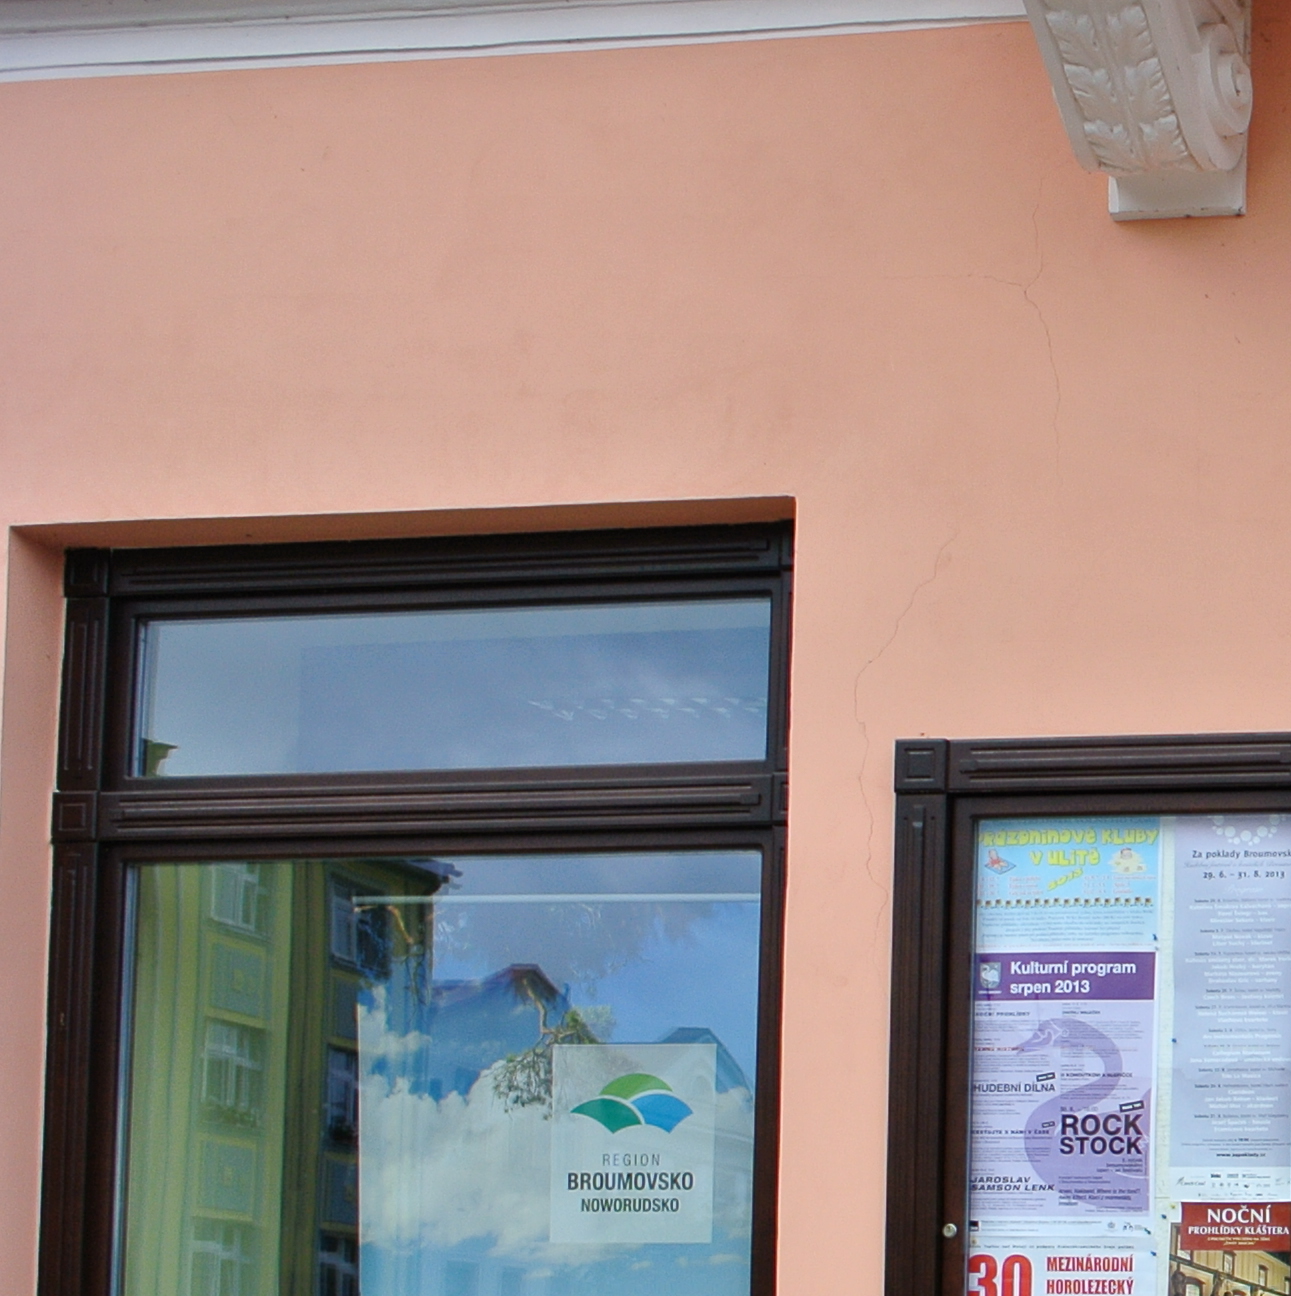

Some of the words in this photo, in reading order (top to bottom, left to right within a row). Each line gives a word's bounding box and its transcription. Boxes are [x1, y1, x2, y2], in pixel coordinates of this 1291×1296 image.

[1191, 849, 1203, 859] Za
[1205, 849, 1241, 860] poklady
[1265, 870, 1285, 880] 2013
[1010, 960, 1069, 975] Kulturní
[1071, 962, 1137, 977] program
[1010, 981, 1051, 996] srpen
[1054, 980, 1091, 994] 2013
[973, 1081, 1021, 1093] HUDEBNÍ
[1024, 1081, 1056, 1093] DÍLNA
[1060, 1113, 1143, 1136] ROCK
[1059, 1136, 1143, 1155] STOCK
[602, 1153, 661, 1167] REGION
[567, 1172, 694, 1191] BROUMOVSKO
[971, 1176, 1031, 1184] JAROSLAV
[970, 1184, 1021, 1192] SAMSON
[581, 1198, 680, 1212] NOWORUDSKO
[1207, 1204, 1272, 1224] NOČNÍ
[1188, 1225, 1242, 1235] PROHLÍDKY
[1244, 1225, 1290, 1235] KLÁŠTERA
[1046, 1254, 1134, 1272] MEZINÁRODNÍ
[1046, 1277, 1134, 1295] HOROLEZECKÝ
